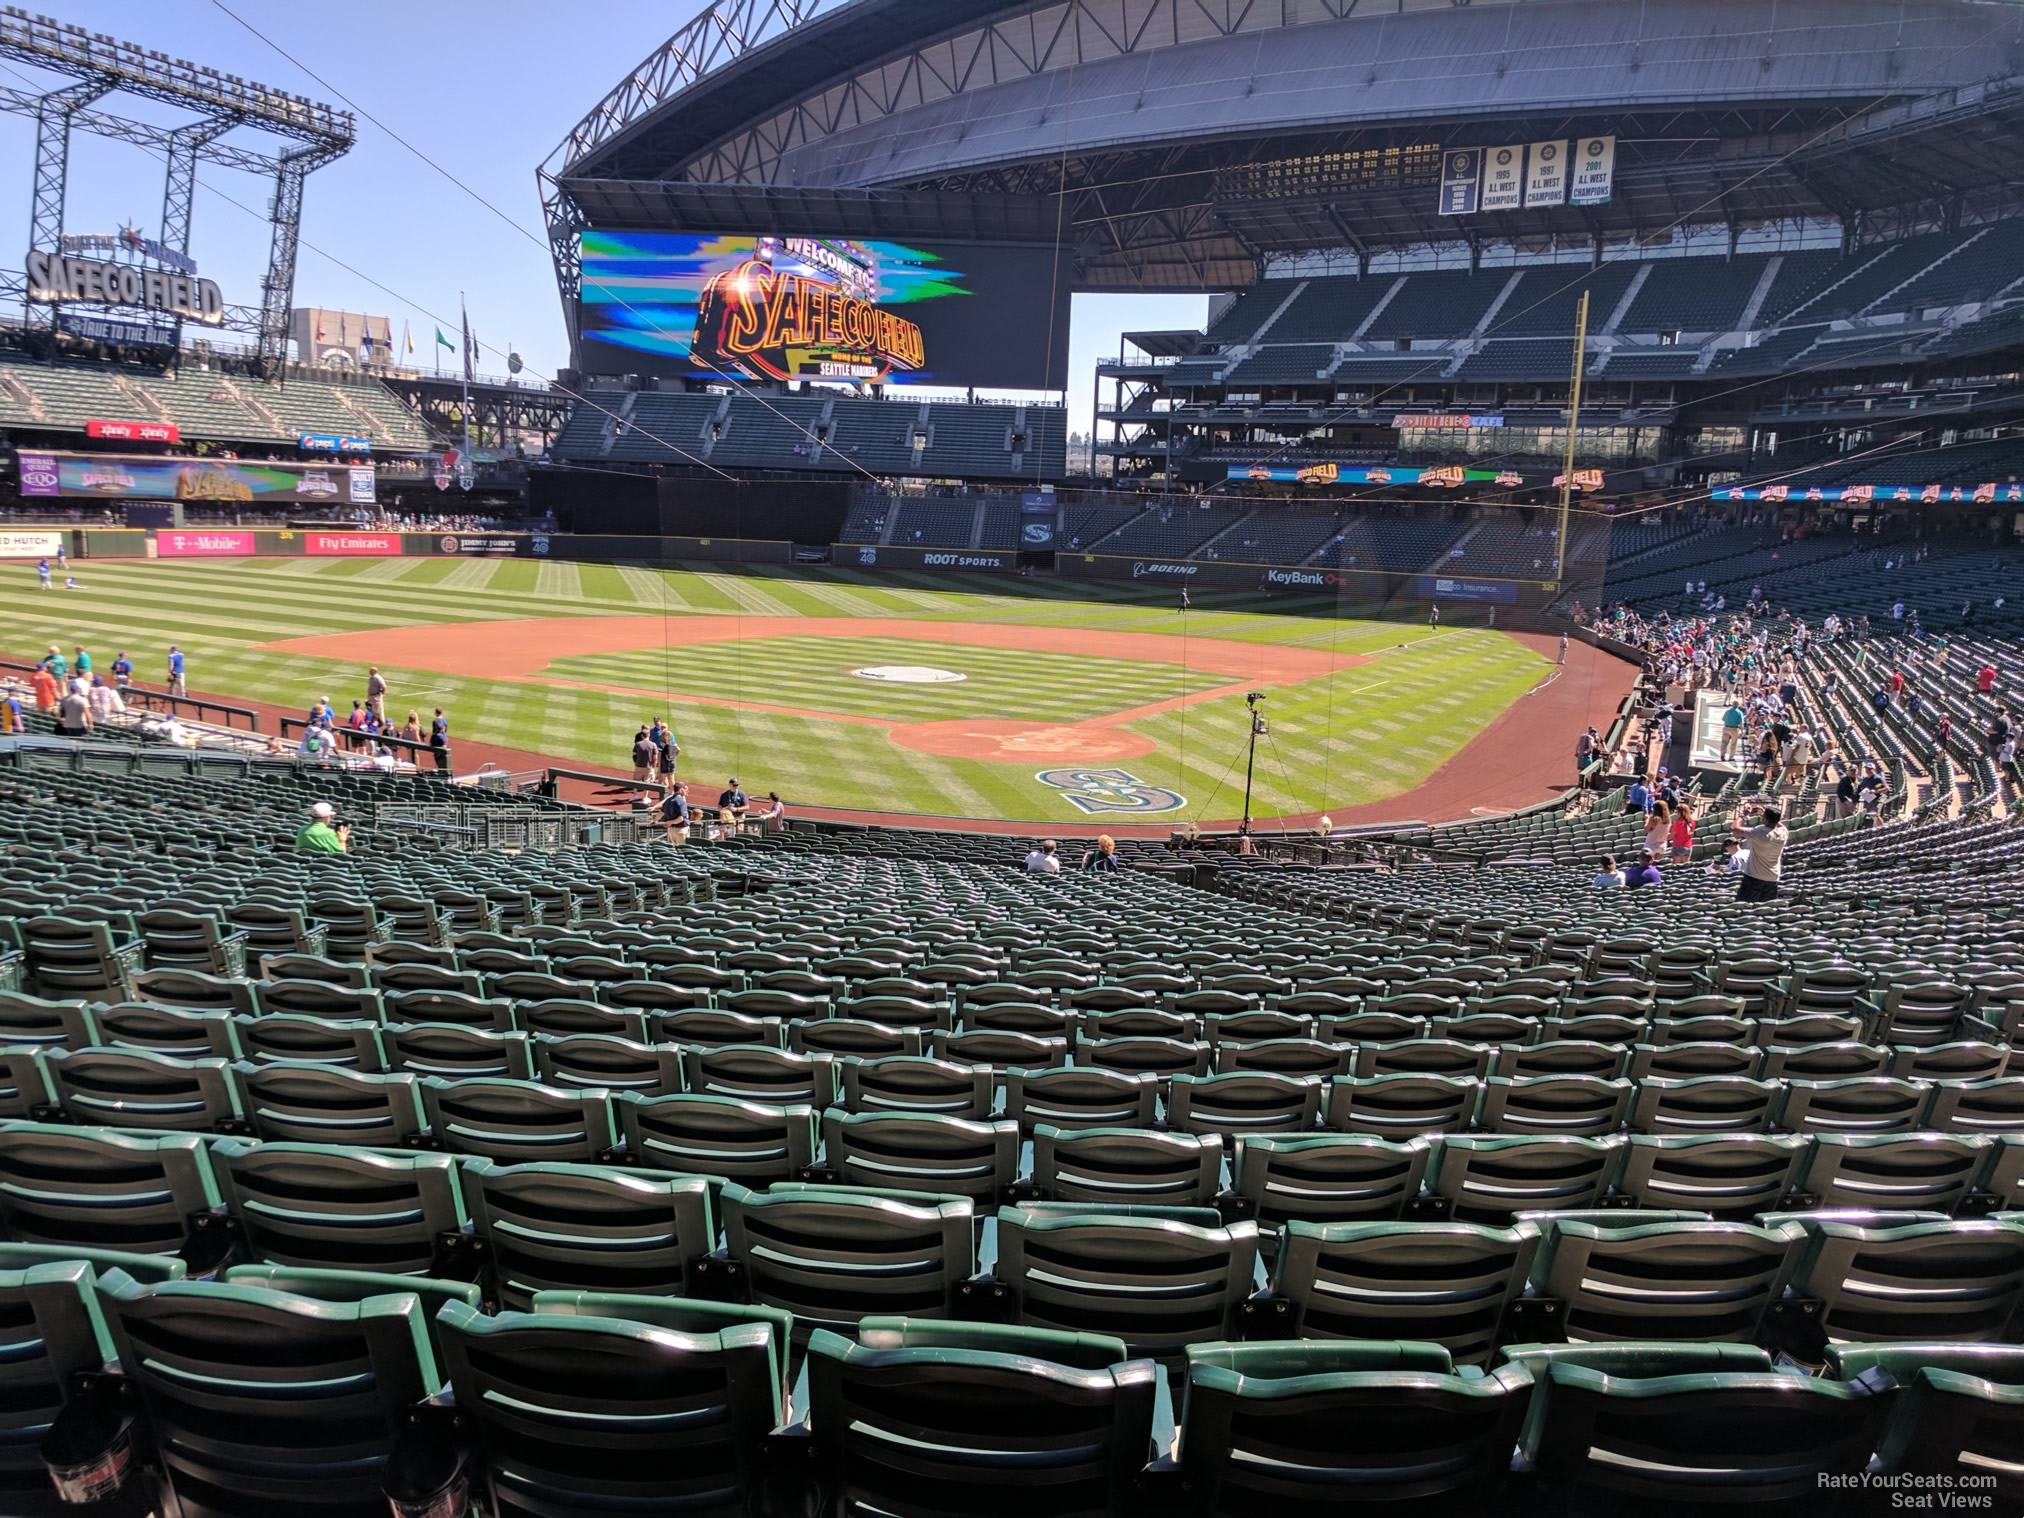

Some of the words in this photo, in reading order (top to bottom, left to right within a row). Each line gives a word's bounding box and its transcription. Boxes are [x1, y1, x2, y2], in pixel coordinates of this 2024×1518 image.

[1586, 162, 1602, 171] 2001
[1543, 178, 1560, 188] WEST
[1590, 174, 1607, 183] WEST
[1500, 182, 1516, 191] WEST
[1574, 186, 1608, 197] CHAMPIONS
[1484, 195, 1518, 206] CHAMPIONS
[1528, 190, 1562, 202] CHAMPIONS
[786, 238, 857, 281] WELCOME
[858, 268, 870, 289] TO
[26, 250, 140, 305] SAFECO
[144, 270, 224, 326] FIELD
[728, 260, 876, 354] SAFECO
[81, 318, 108, 337] TRUE
[110, 324, 124, 340] TO
[126, 324, 144, 341] THE
[145, 325, 172, 345] BLUE
[820, 363, 850, 375] SEATTLE
[851, 364, 878, 377] MARINERS
[315, 440, 335, 450] pepsi
[350, 442, 369, 452] pepsi
[1313, 464, 1338, 478] FIELD
[1436, 467, 1464, 482] FIELD
[319, 537, 339, 550] Fly
[341, 537, 388, 549] Emirates
[924, 554, 958, 565] ROOT
[959, 557, 1000, 567] SPORTS
[1148, 564, 1198, 575] BOEING
[1268, 570, 1324, 586] KeyBank
[1463, 583, 1497, 593] Insurance
[1035, 768, 1188, 814] S
